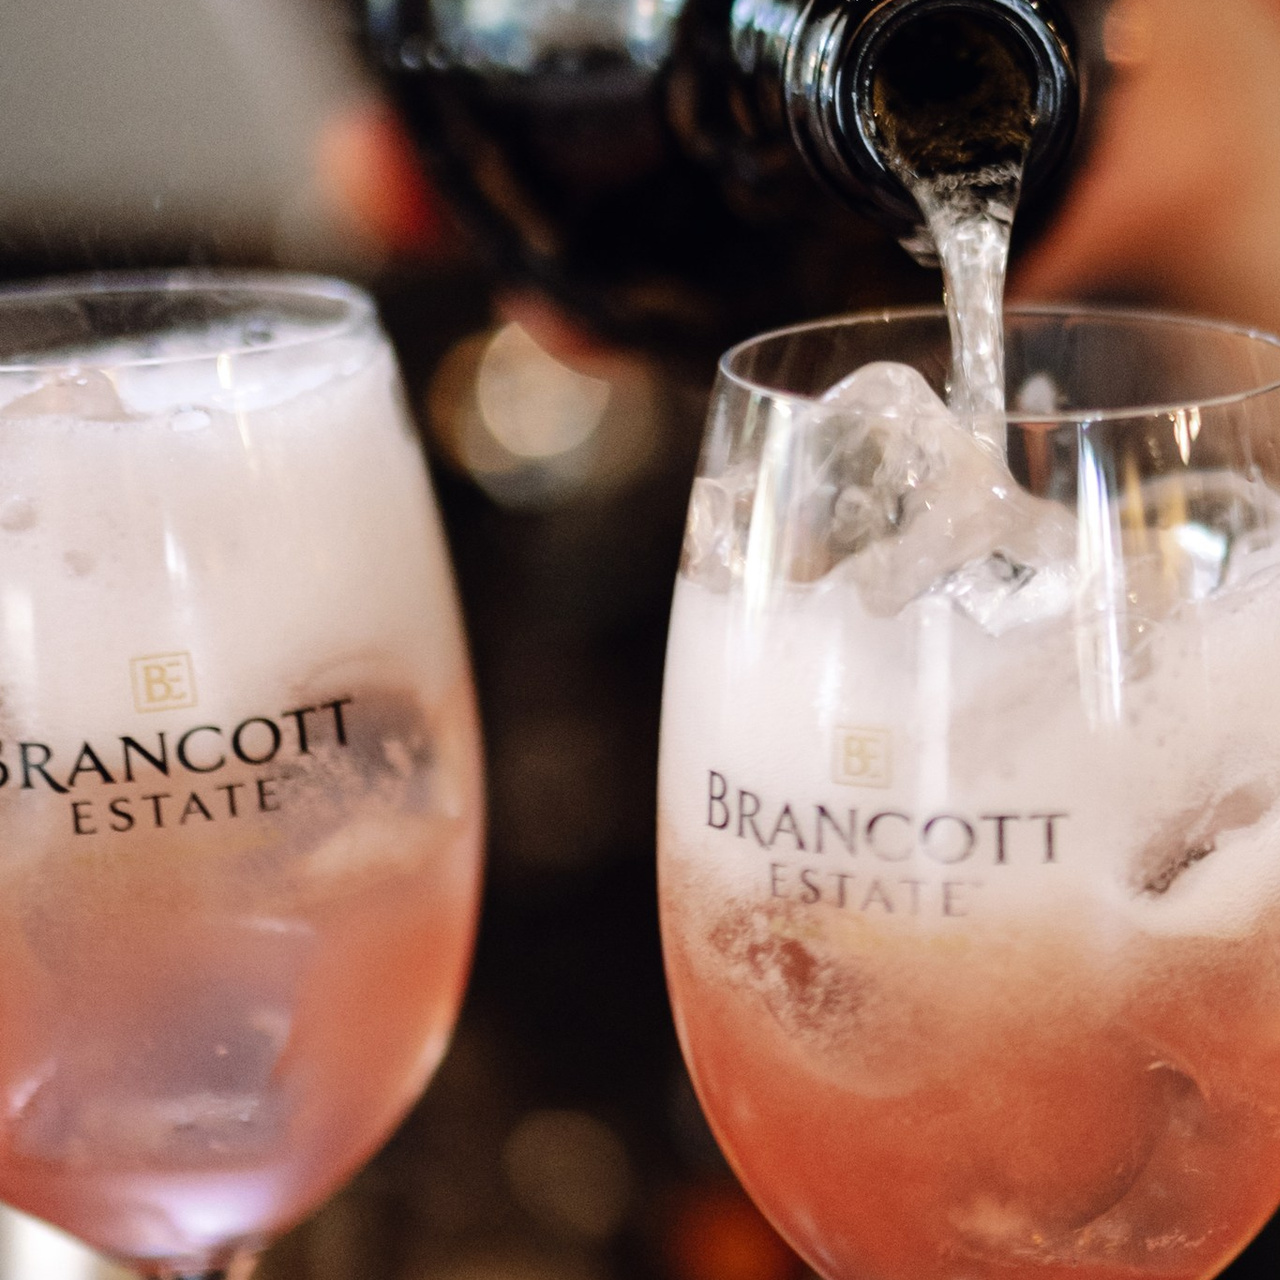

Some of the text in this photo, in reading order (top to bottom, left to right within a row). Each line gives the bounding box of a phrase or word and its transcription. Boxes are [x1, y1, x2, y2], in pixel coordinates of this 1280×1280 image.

[0, 698, 352, 794] RANCOTT
[71, 776, 283, 836] ESTATE
[706, 770, 1070, 866] BRANCOTT
[769, 863, 972, 918] ESTATE
